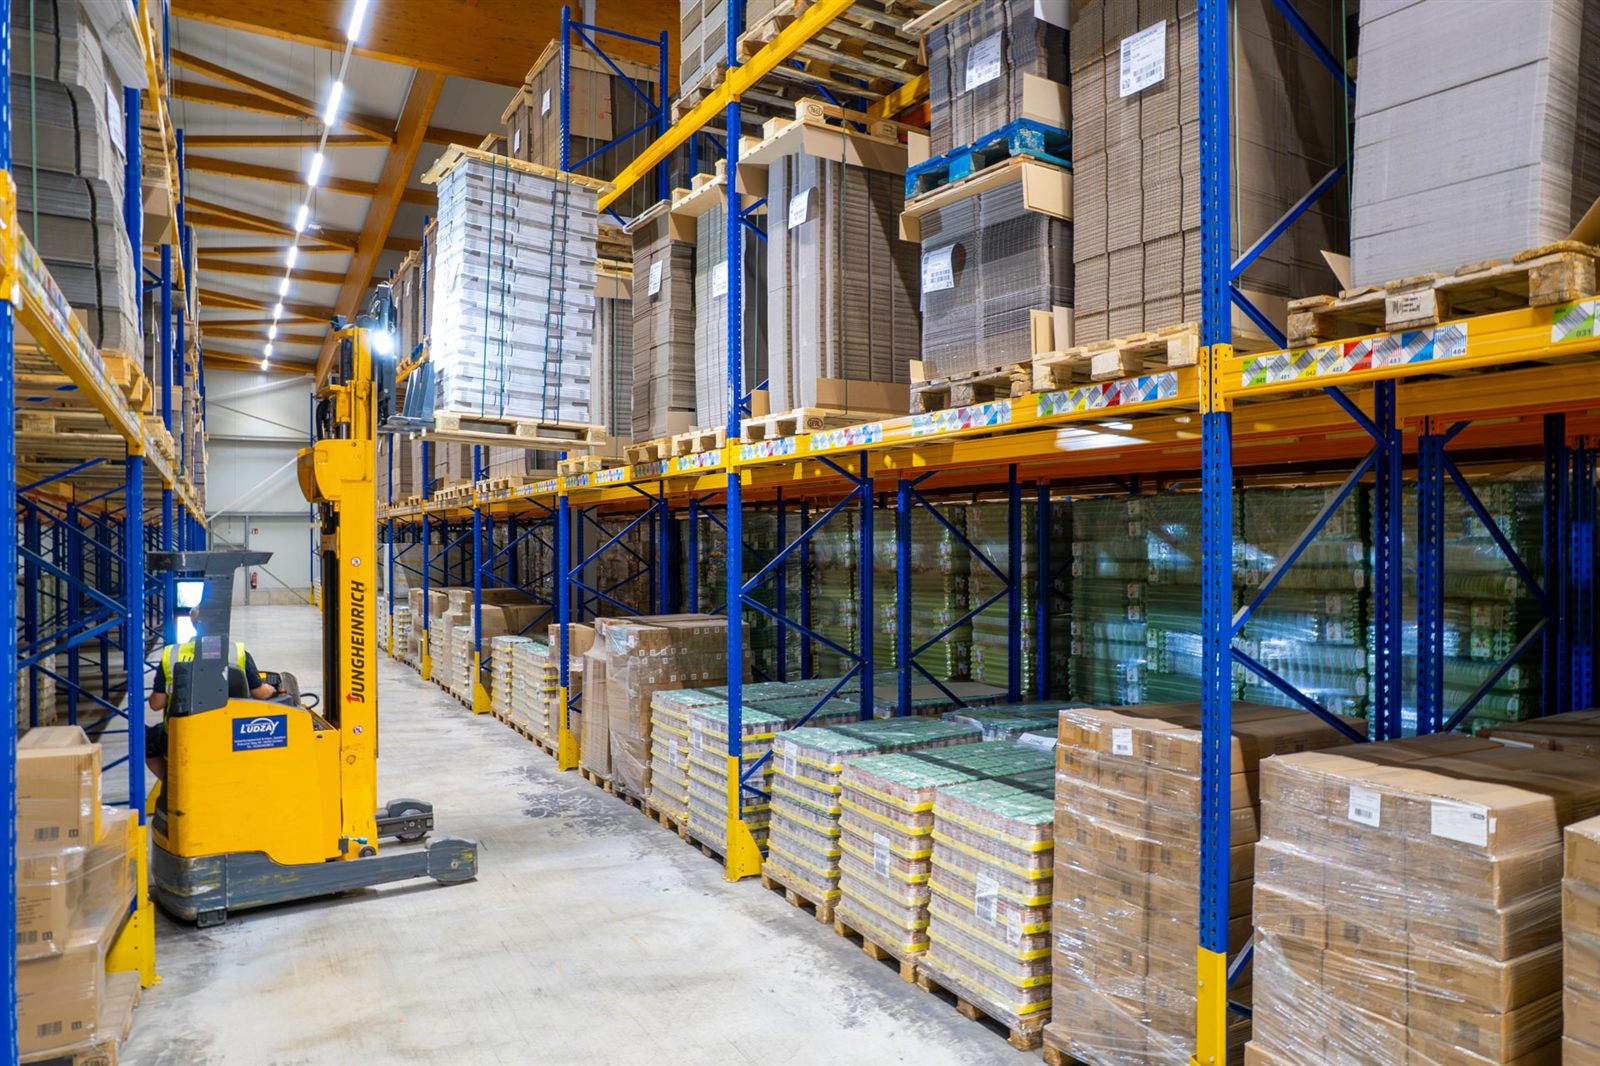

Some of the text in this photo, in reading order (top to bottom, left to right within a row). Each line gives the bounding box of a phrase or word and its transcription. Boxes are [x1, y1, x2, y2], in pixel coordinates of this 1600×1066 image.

[1575, 328, 1592, 337] 031
[350, 580, 365, 703] JUNGHEINRICH
[240, 720, 279, 736] LUDZAY
